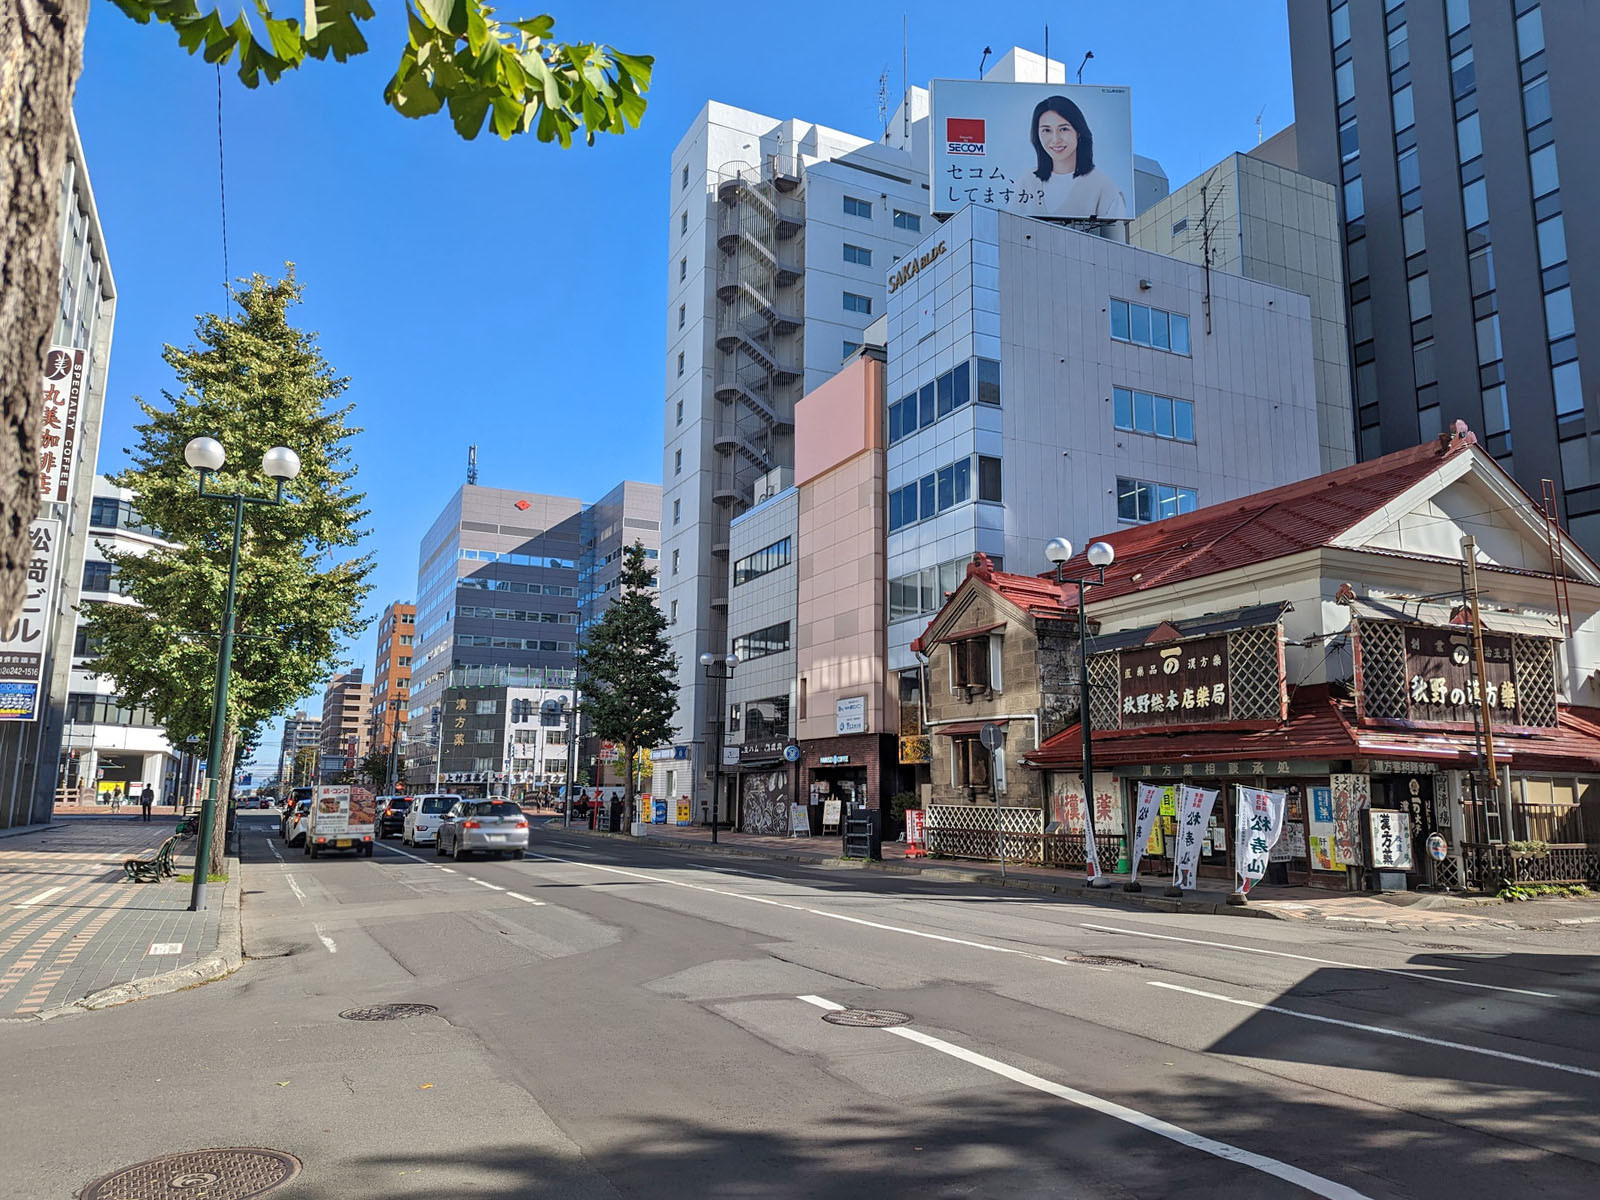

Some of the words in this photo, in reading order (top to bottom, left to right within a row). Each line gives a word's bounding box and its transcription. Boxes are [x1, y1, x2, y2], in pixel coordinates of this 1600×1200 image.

[948, 143, 984, 153] SECOM
[949, 186, 1045, 205] してますか?
[888, 257, 920, 294] SAKA
[66, 364, 82, 430] SPECIALTY
[59, 439, 73, 487] COFFEE
